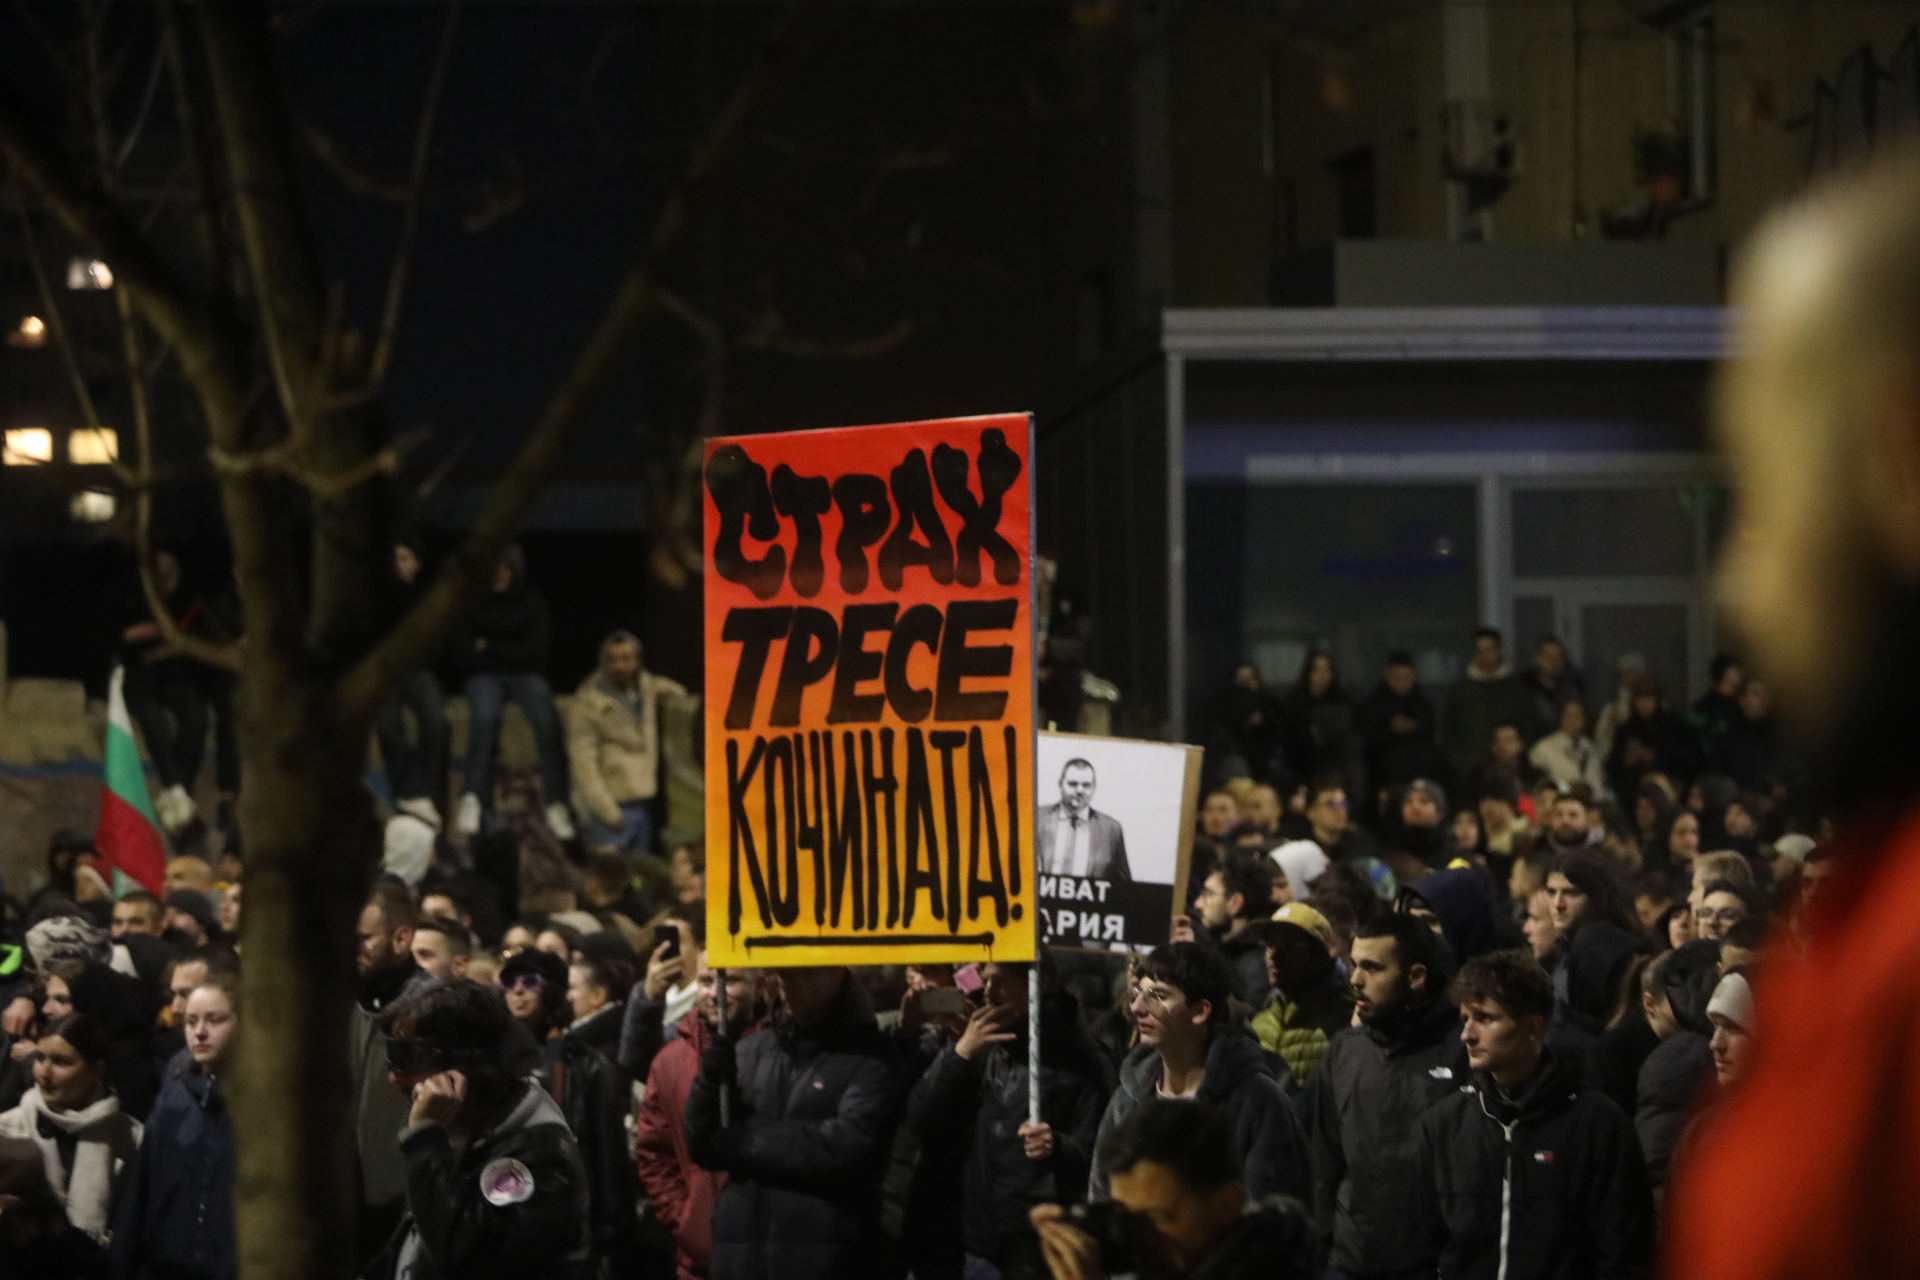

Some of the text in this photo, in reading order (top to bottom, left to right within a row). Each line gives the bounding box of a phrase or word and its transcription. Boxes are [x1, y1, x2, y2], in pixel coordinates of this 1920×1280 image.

[705, 428, 1021, 600] СТРАХ
[721, 598, 1019, 730] ТРЕСЕ
[727, 725, 1023, 936] КОЧИНАТА!
